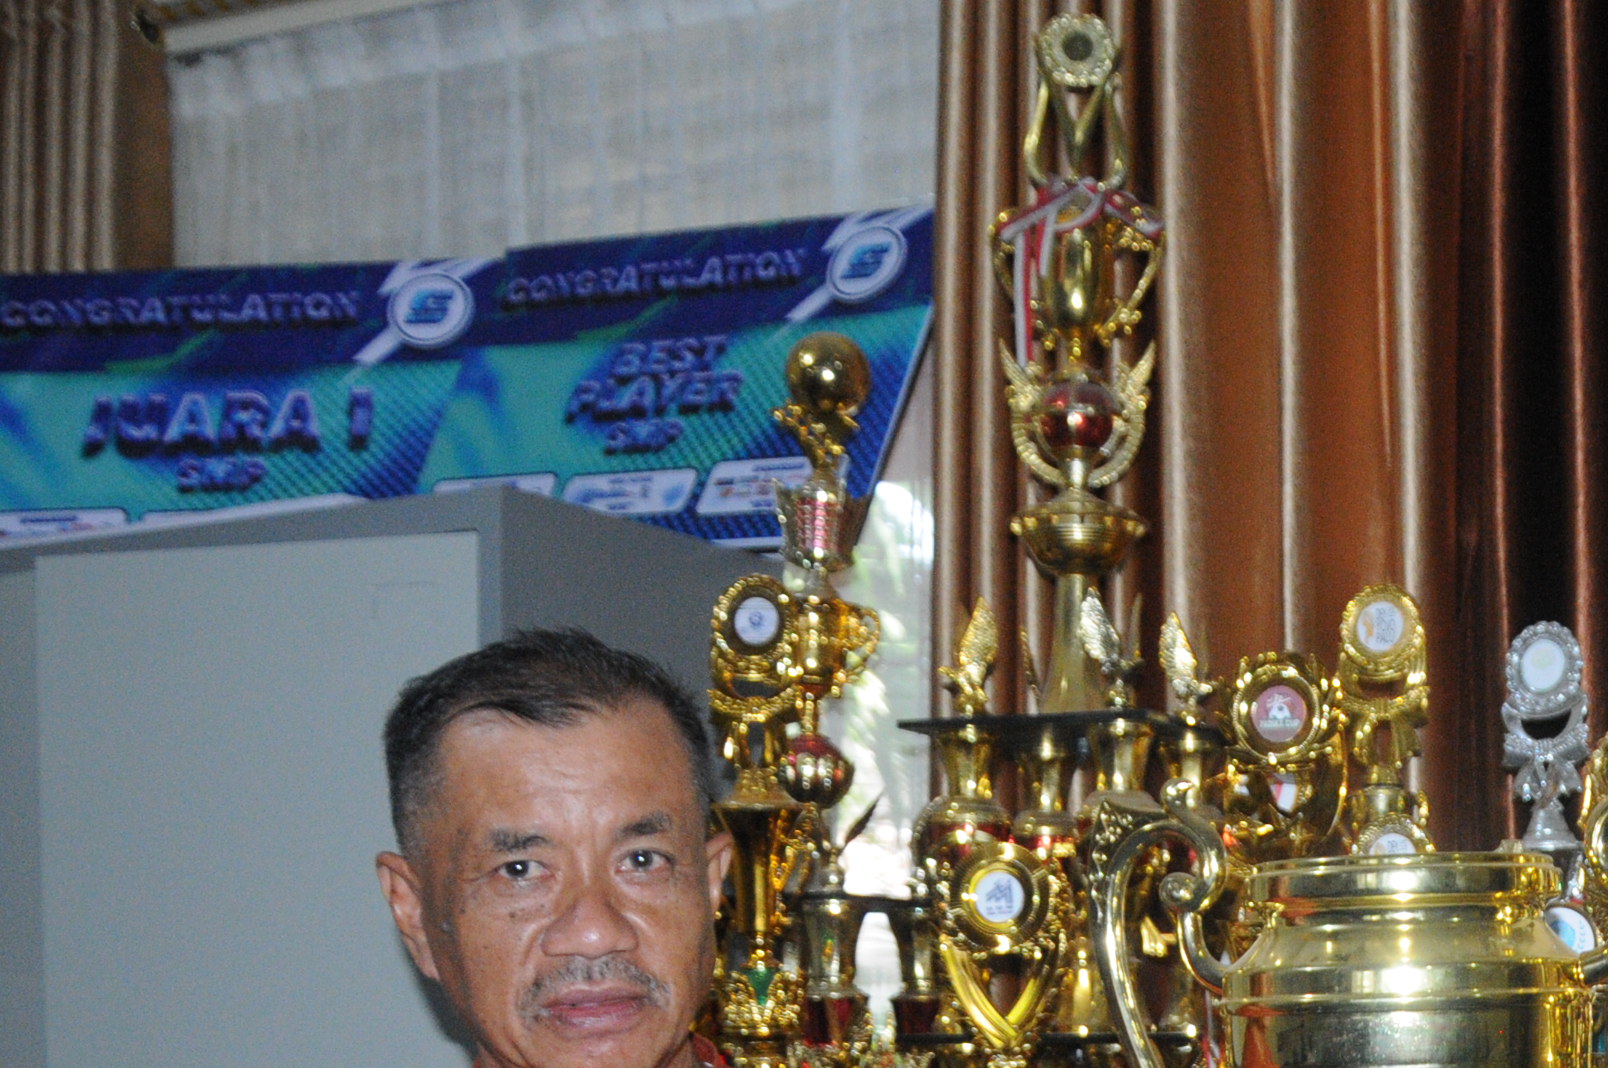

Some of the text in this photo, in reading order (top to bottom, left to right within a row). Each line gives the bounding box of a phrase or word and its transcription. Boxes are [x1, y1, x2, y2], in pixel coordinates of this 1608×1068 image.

[503, 250, 804, 304] CONGRATULATION
[1, 292, 358, 328] CONGRATULATION
[611, 334, 728, 384] BEST
[567, 369, 743, 420] PLAYER
[82, 390, 320, 457] JUARA
